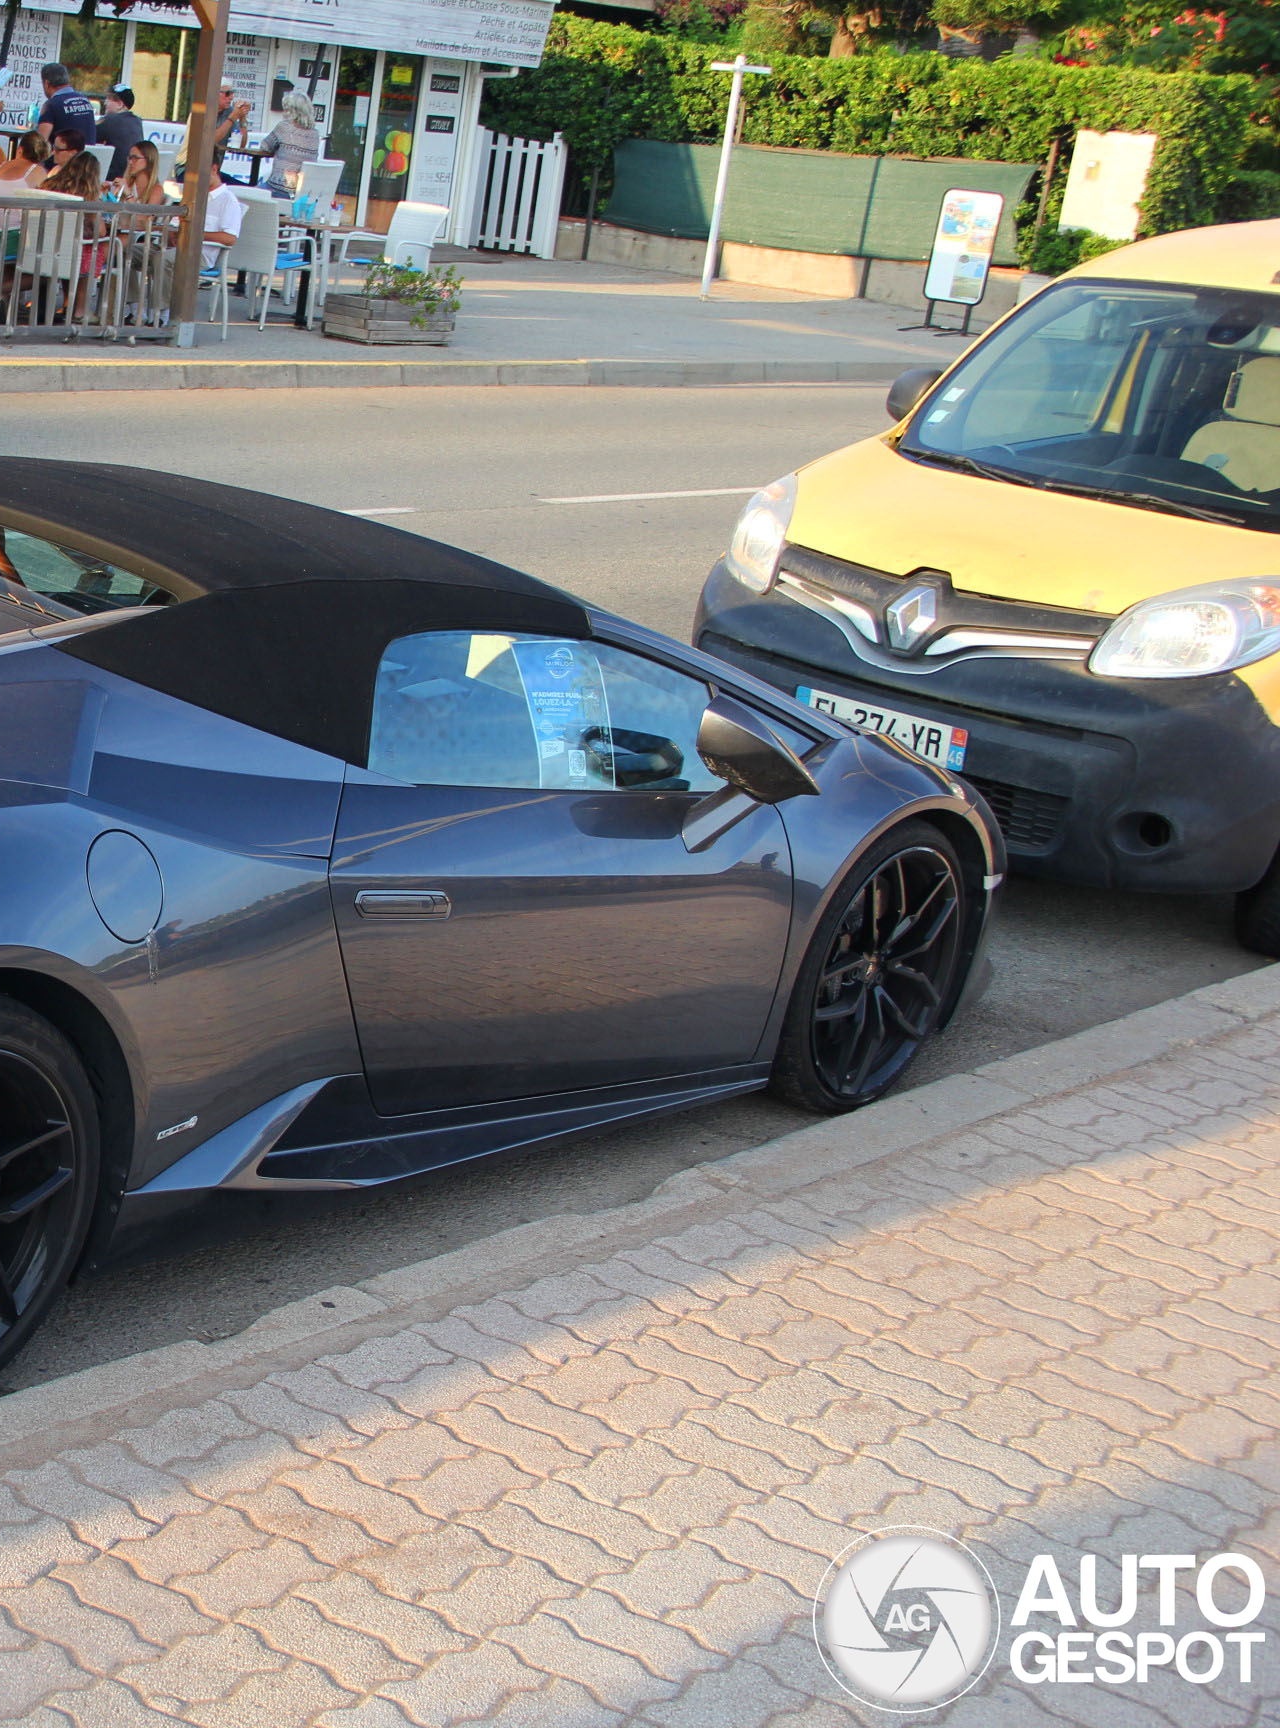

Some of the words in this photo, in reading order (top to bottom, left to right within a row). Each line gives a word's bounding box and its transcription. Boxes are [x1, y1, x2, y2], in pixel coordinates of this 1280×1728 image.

[500, 3, 549, 18] Sous-Marine
[474, 30, 506, 43] Articles
[507, 34, 518, 44] de
[520, 36, 541, 49] Plage
[416, 38, 449, 51] Maillots
[461, 43, 480, 55] Bain
[492, 46, 538, 62] Accessoires
[305, 63, 326, 78] DY
[948, 749, 963, 767] 46
